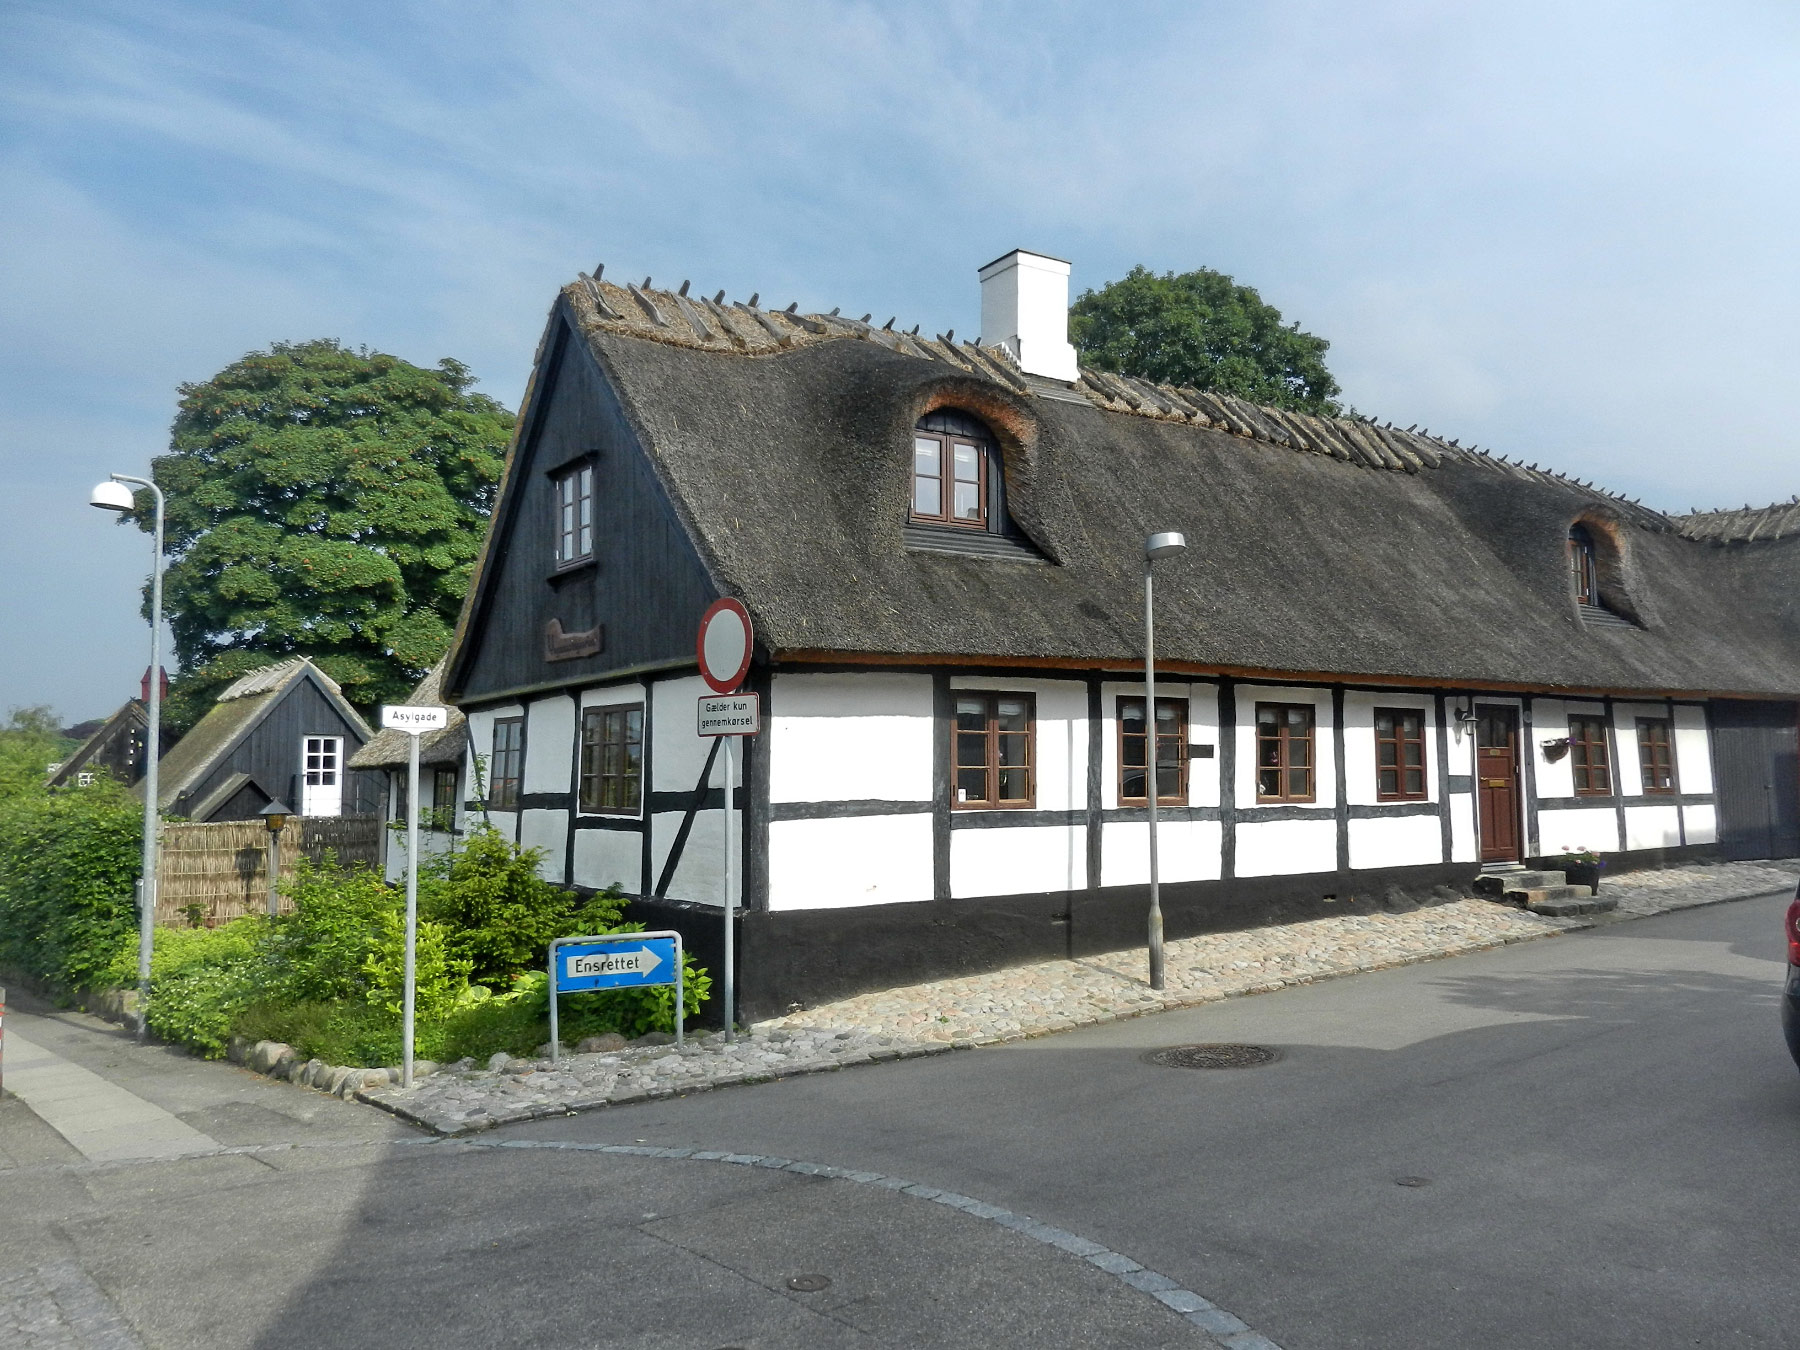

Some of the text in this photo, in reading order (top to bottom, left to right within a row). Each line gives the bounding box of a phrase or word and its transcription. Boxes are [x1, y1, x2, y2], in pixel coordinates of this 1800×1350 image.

[705, 701, 747, 712] Gælder kun
[392, 710, 437, 723] Asylgade
[701, 716, 753, 729] gennemkørsel
[575, 956, 640, 973] Ensrettet
